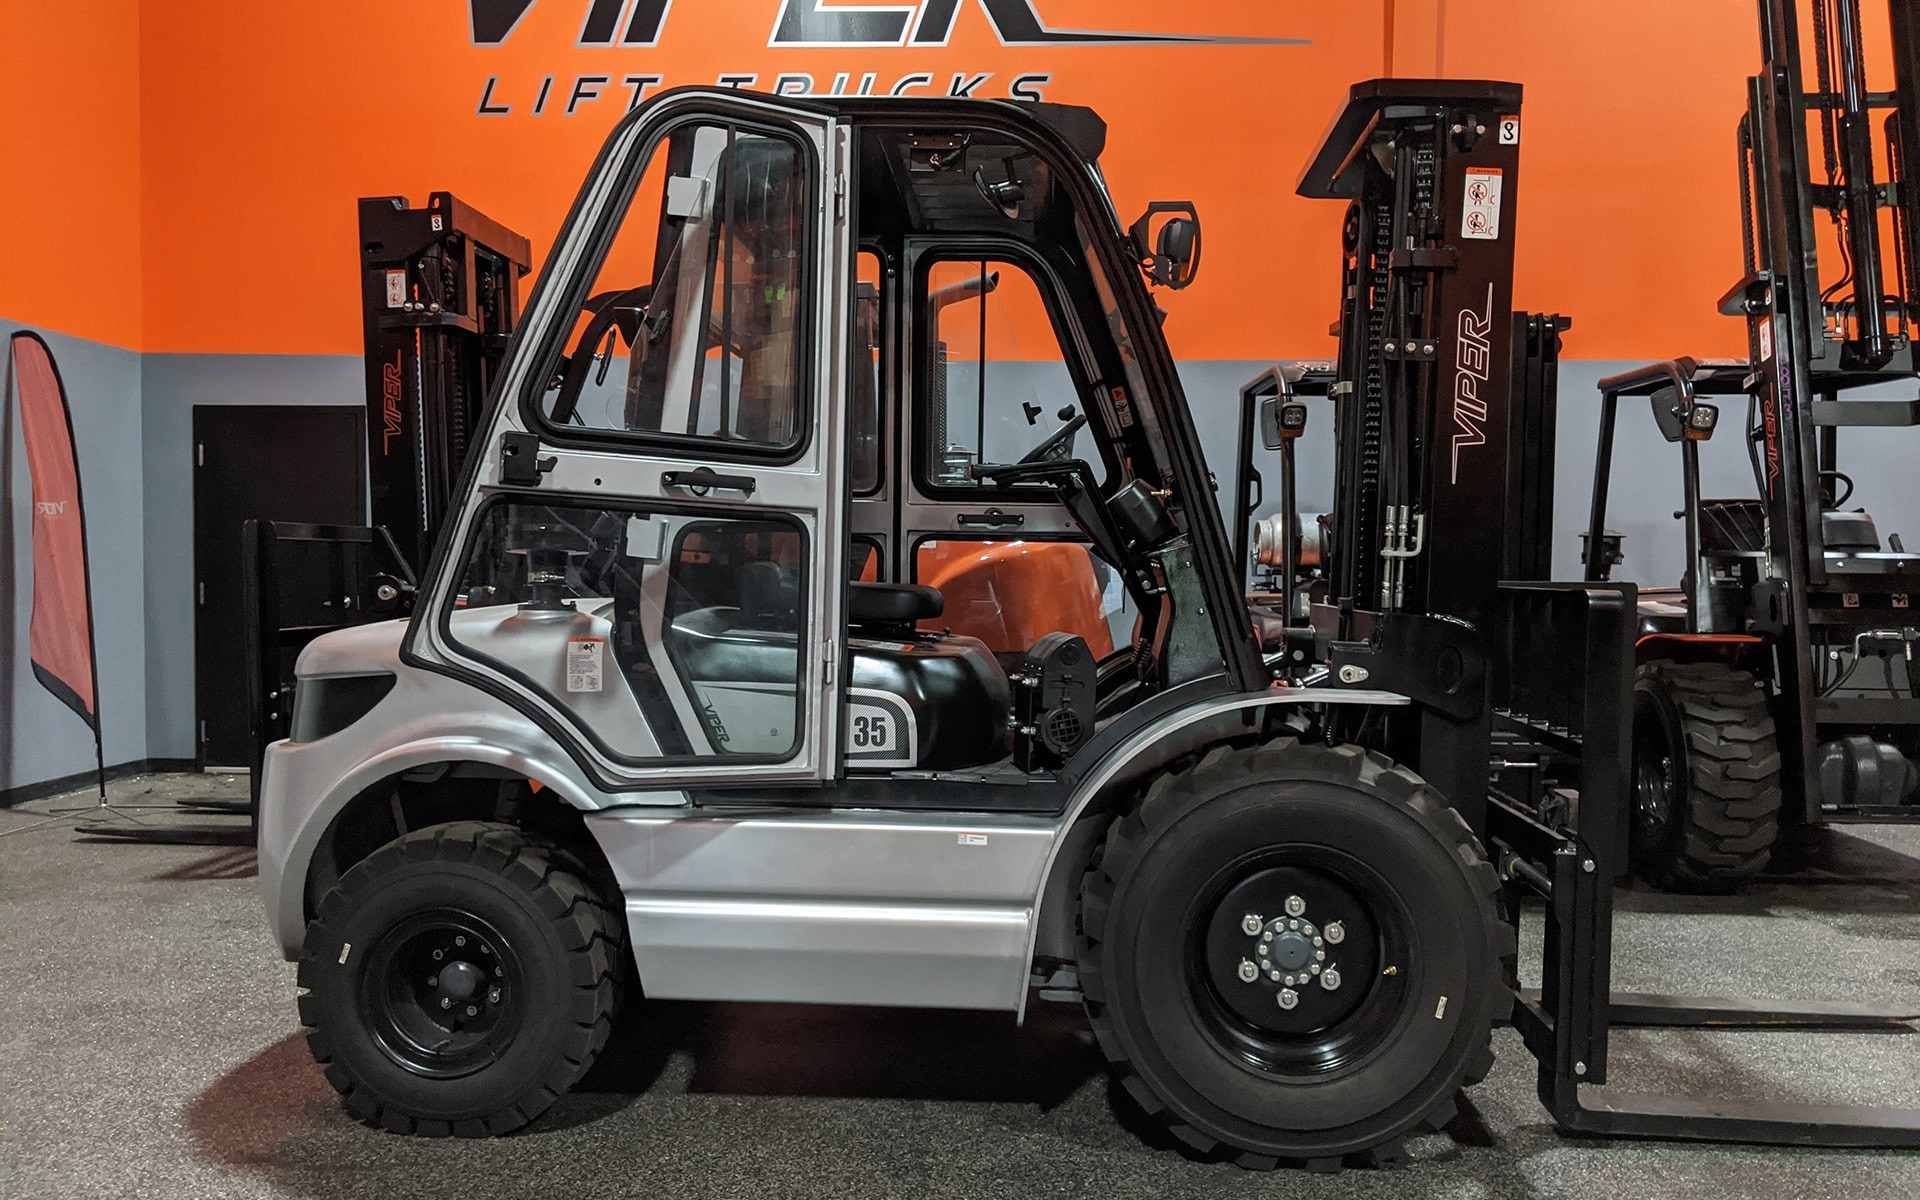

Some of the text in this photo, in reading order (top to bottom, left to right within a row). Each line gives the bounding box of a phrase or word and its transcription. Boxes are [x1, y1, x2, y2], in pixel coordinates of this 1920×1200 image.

[476, 73, 664, 116] LIFT
[384, 349, 402, 456] VIPER
[1452, 282, 1493, 485] VIPER
[1763, 382, 1779, 501] VIPER
[854, 716, 886, 747] 35
